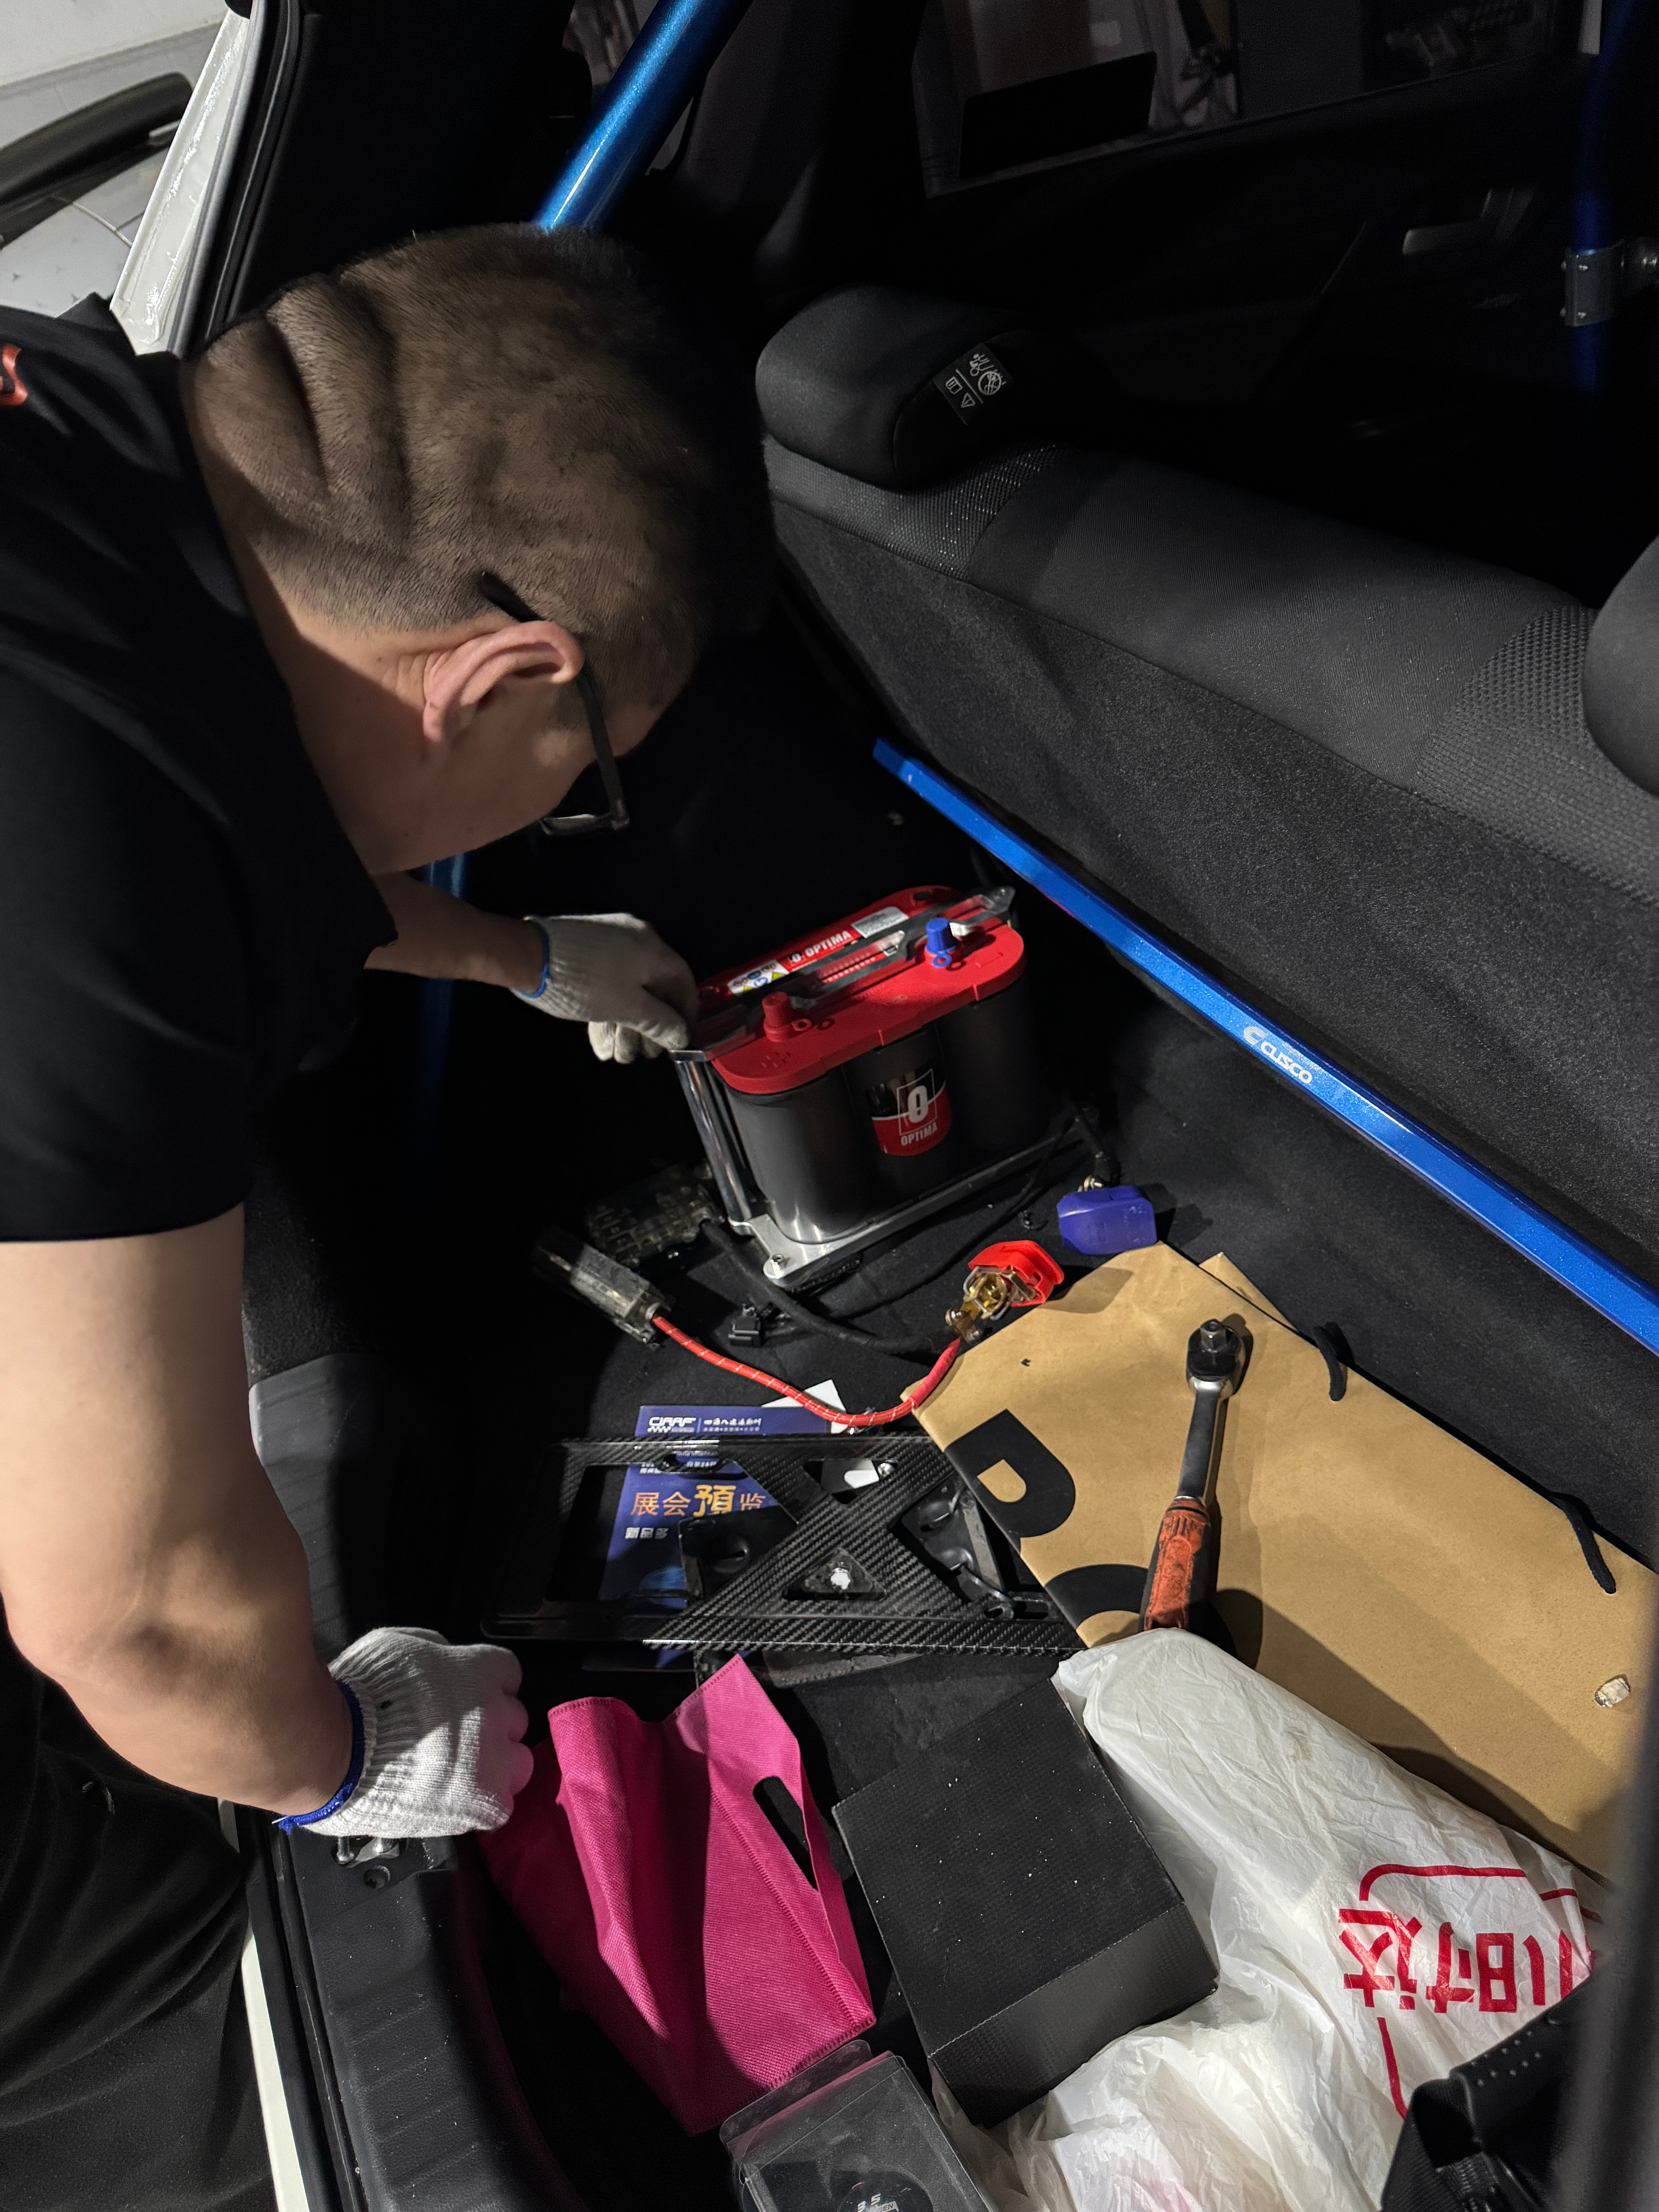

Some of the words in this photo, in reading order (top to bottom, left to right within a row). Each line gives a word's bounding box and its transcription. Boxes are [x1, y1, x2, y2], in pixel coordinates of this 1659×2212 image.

[804, 930, 852, 957] OPTIMA
[1261, 1041, 1312, 1084] CUSCO
[900, 1121, 938, 1146] OPTIMA
